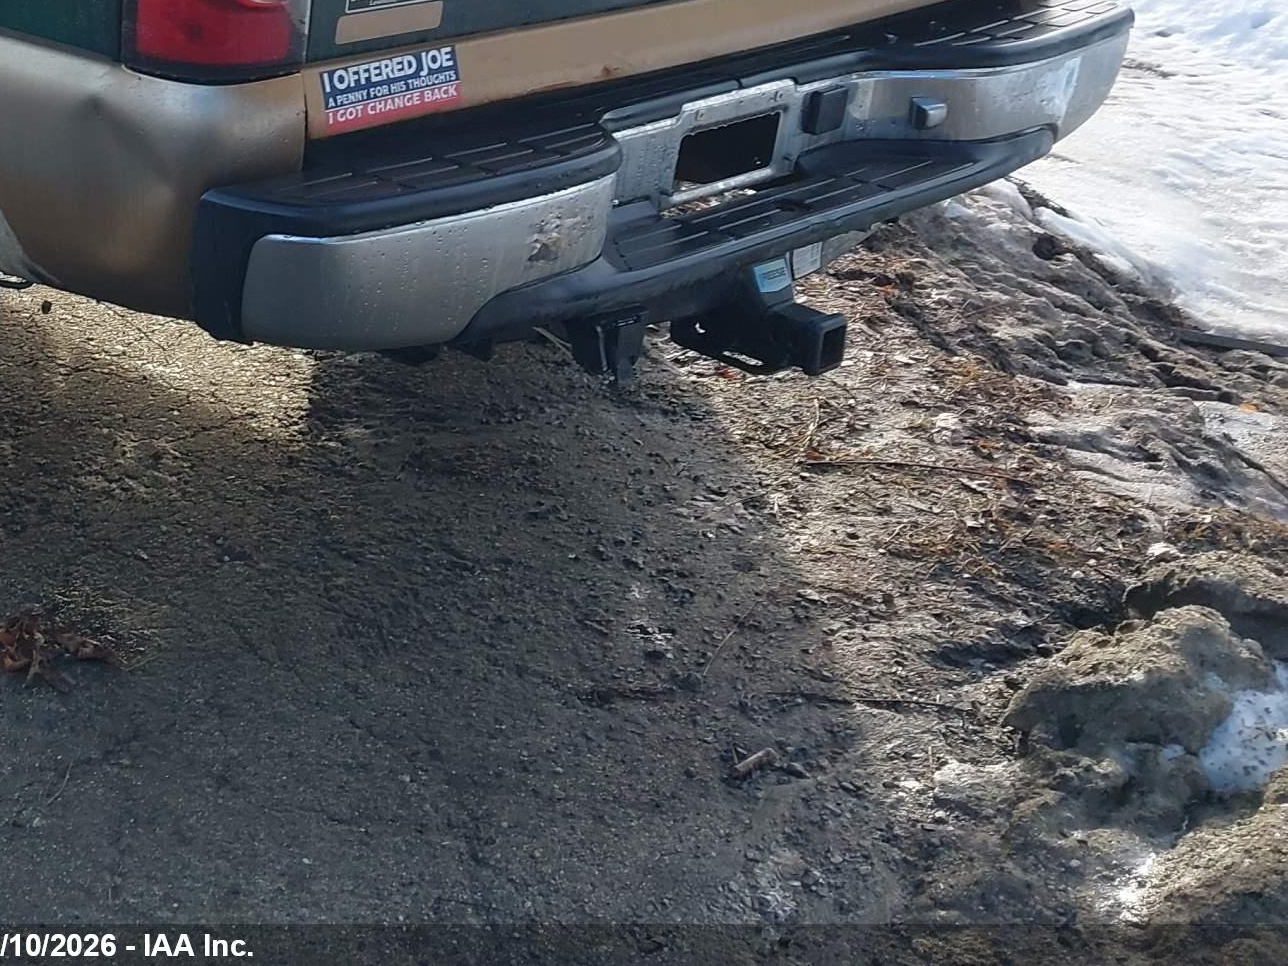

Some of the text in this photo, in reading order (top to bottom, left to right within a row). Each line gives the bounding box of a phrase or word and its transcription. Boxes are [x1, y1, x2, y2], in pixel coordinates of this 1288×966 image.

[323, 46, 454, 92] I OFFERED JOE
[328, 70, 457, 108] A PENNY FOR HIS THOUGHTS
[328, 84, 458, 124] I GOT CHANGE BACK
